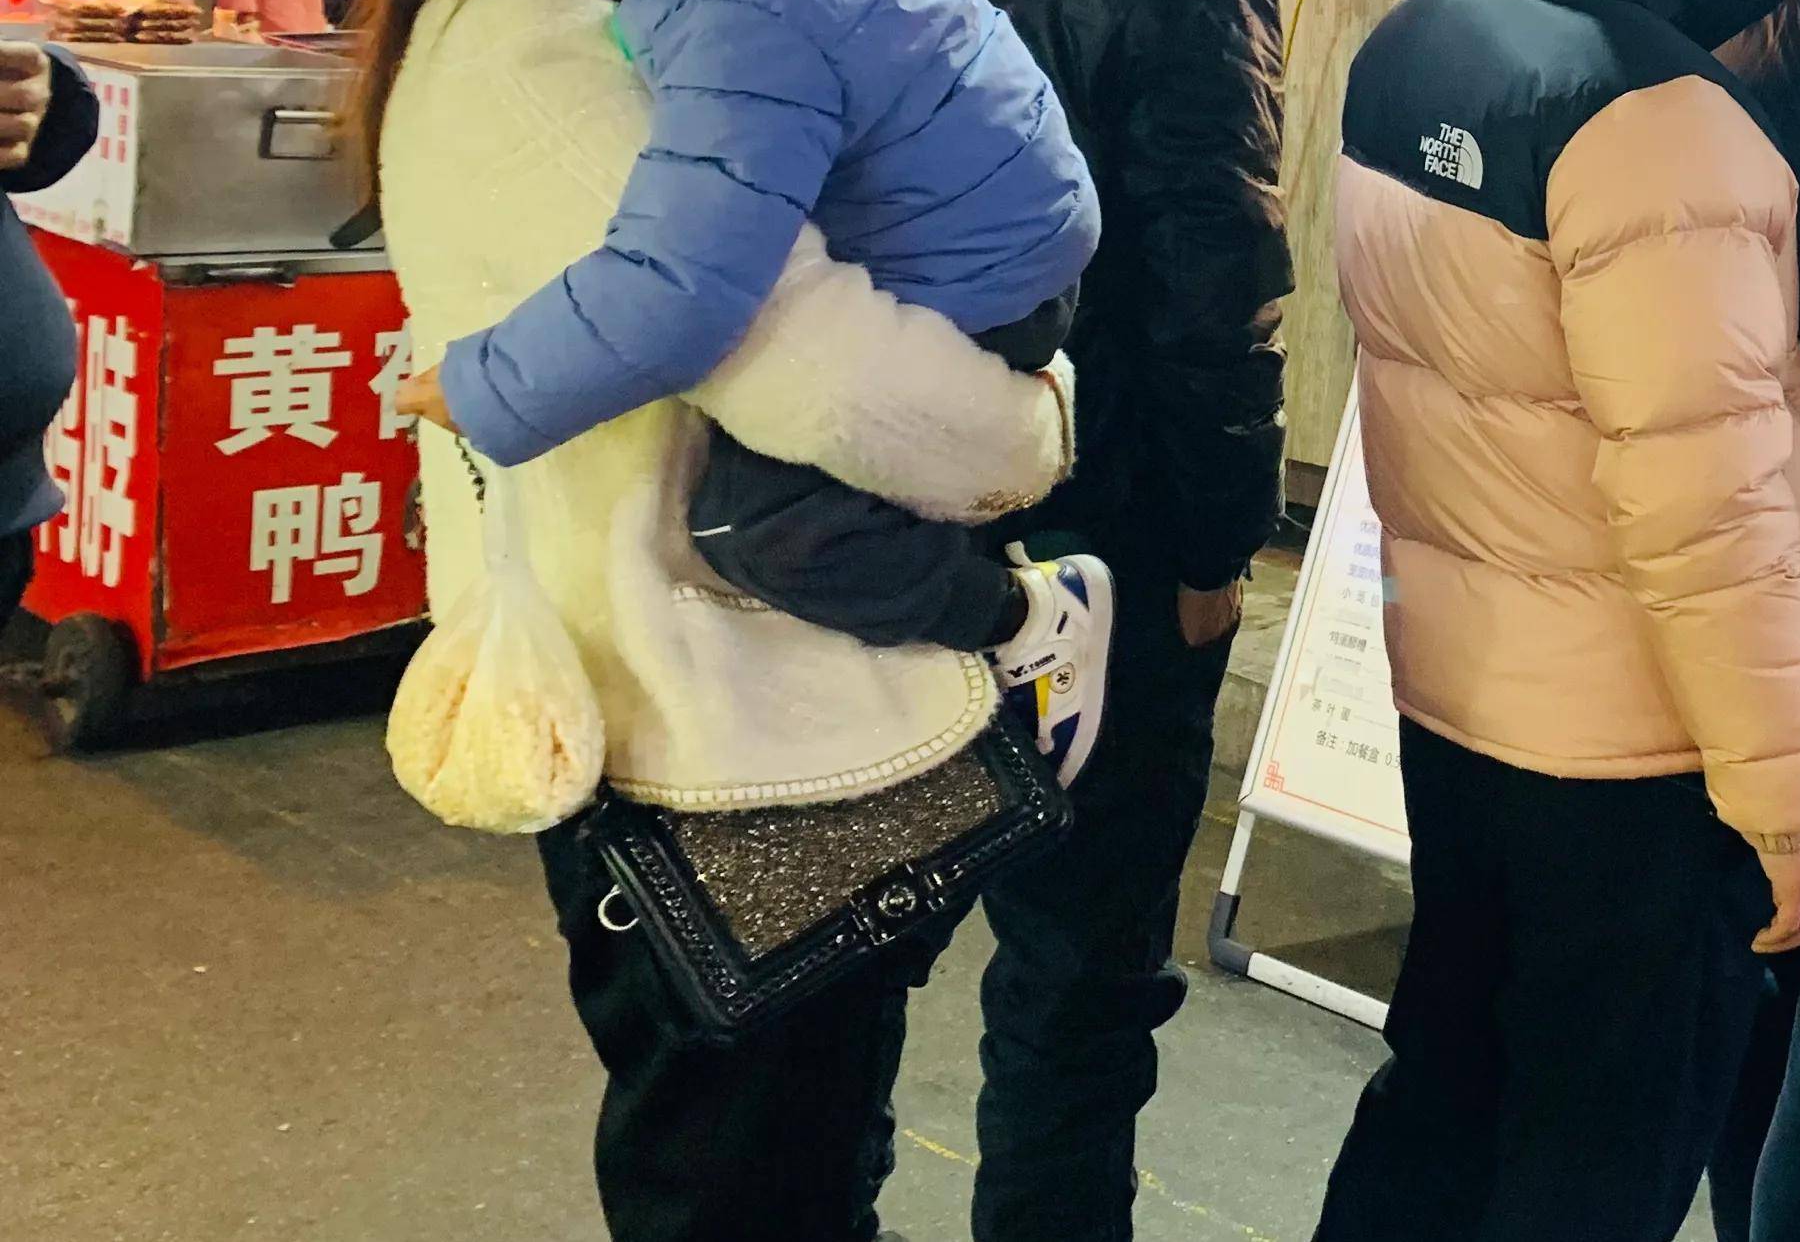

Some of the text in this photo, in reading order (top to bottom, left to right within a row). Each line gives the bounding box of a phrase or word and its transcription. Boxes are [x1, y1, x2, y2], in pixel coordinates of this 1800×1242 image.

[1438, 122, 1464, 146] THE
[1419, 135, 1460, 162] NORTH
[1424, 154, 1458, 180] FACE
[249, 472, 383, 604] 鸭
